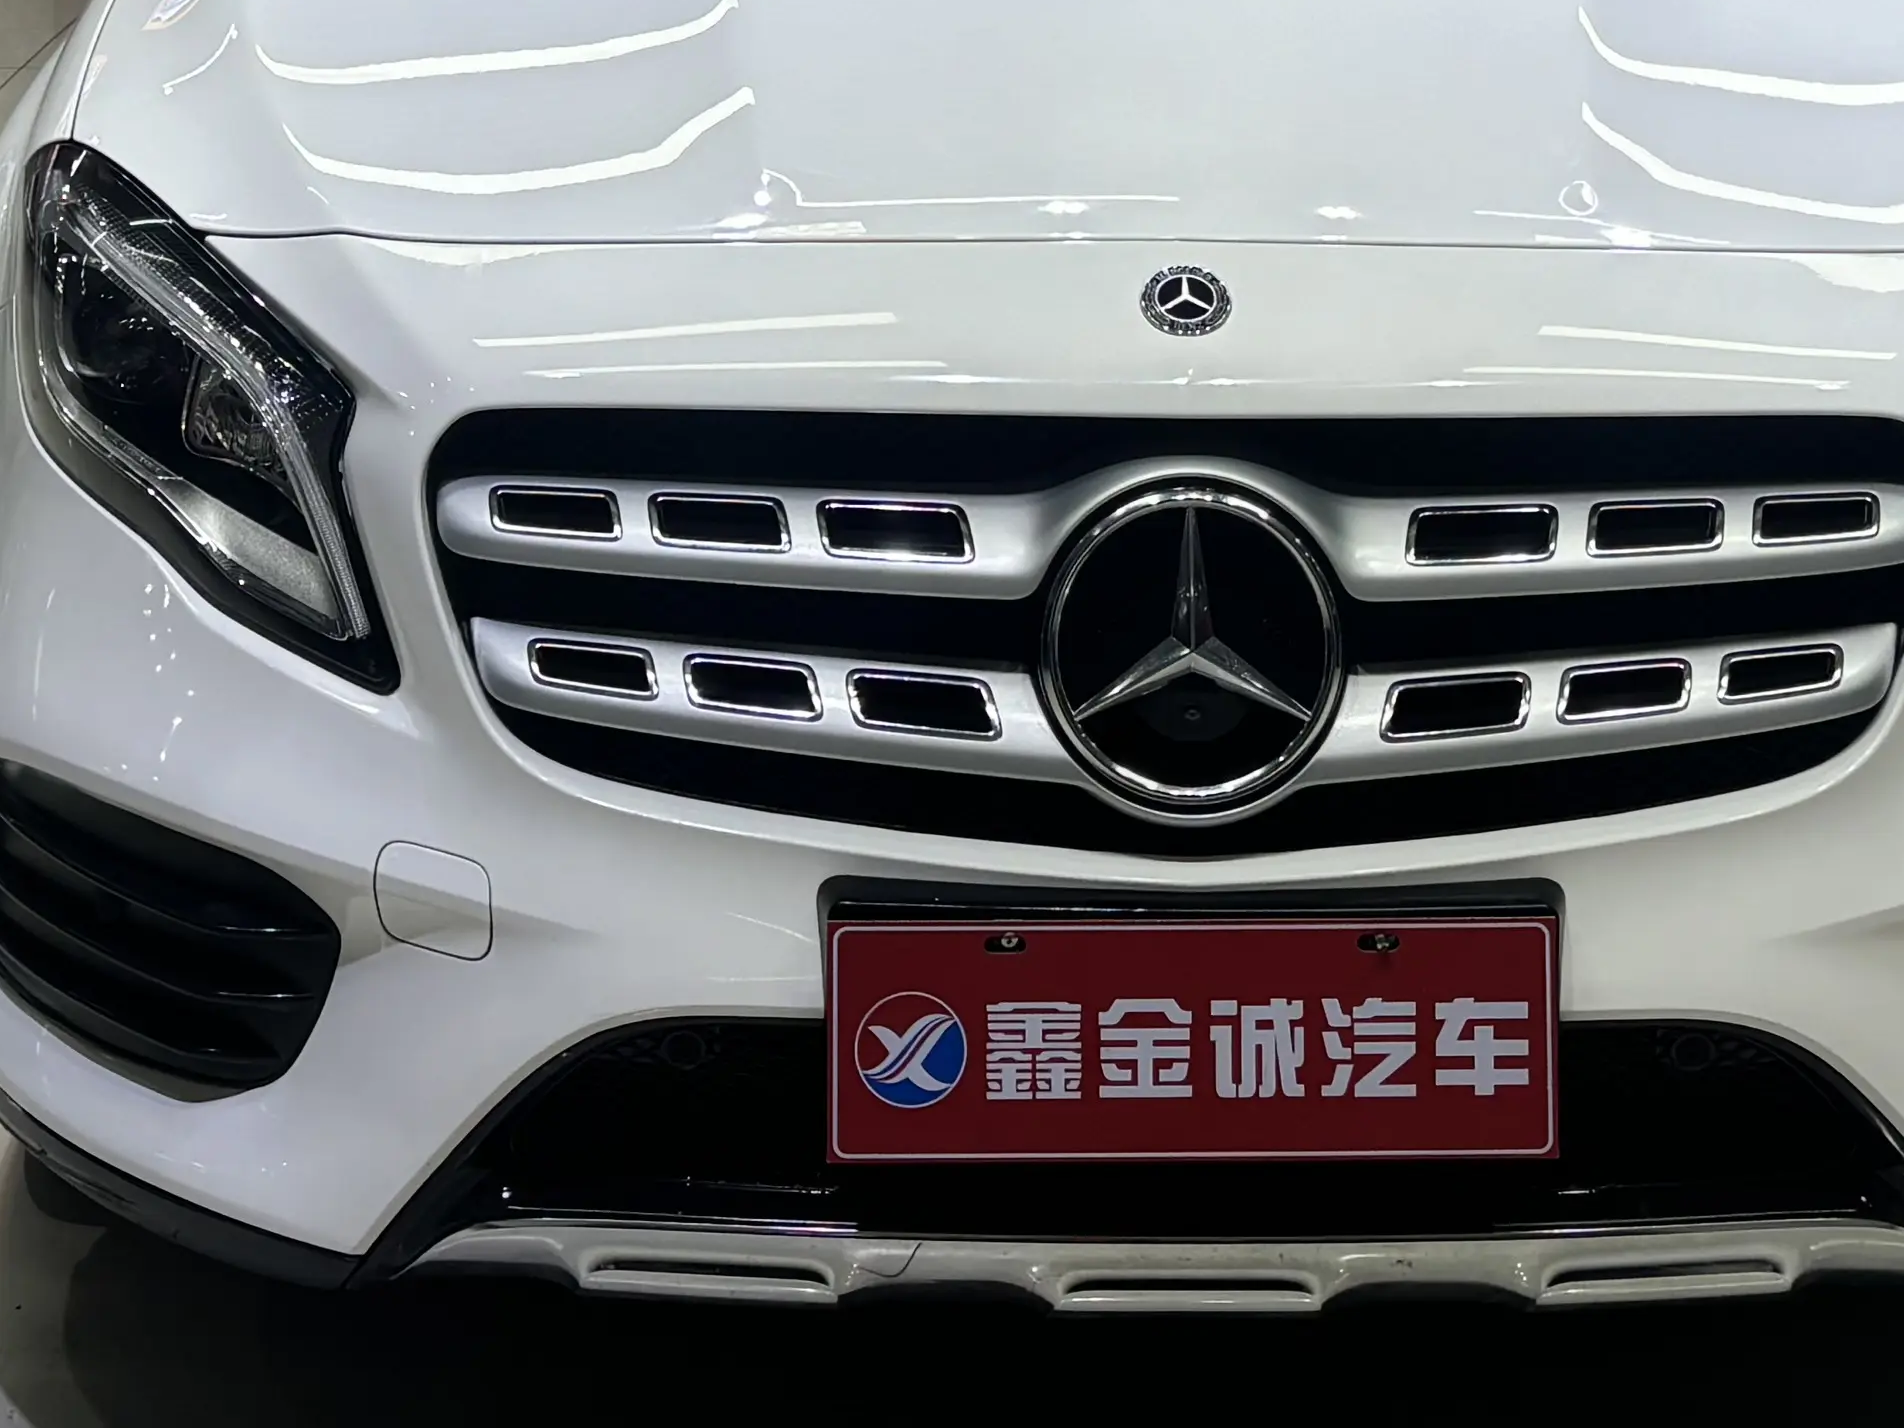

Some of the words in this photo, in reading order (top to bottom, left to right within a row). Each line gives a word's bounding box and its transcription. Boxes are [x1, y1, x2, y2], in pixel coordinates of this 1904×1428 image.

[985, 997, 1529, 1100] 鑫金诚汽车
